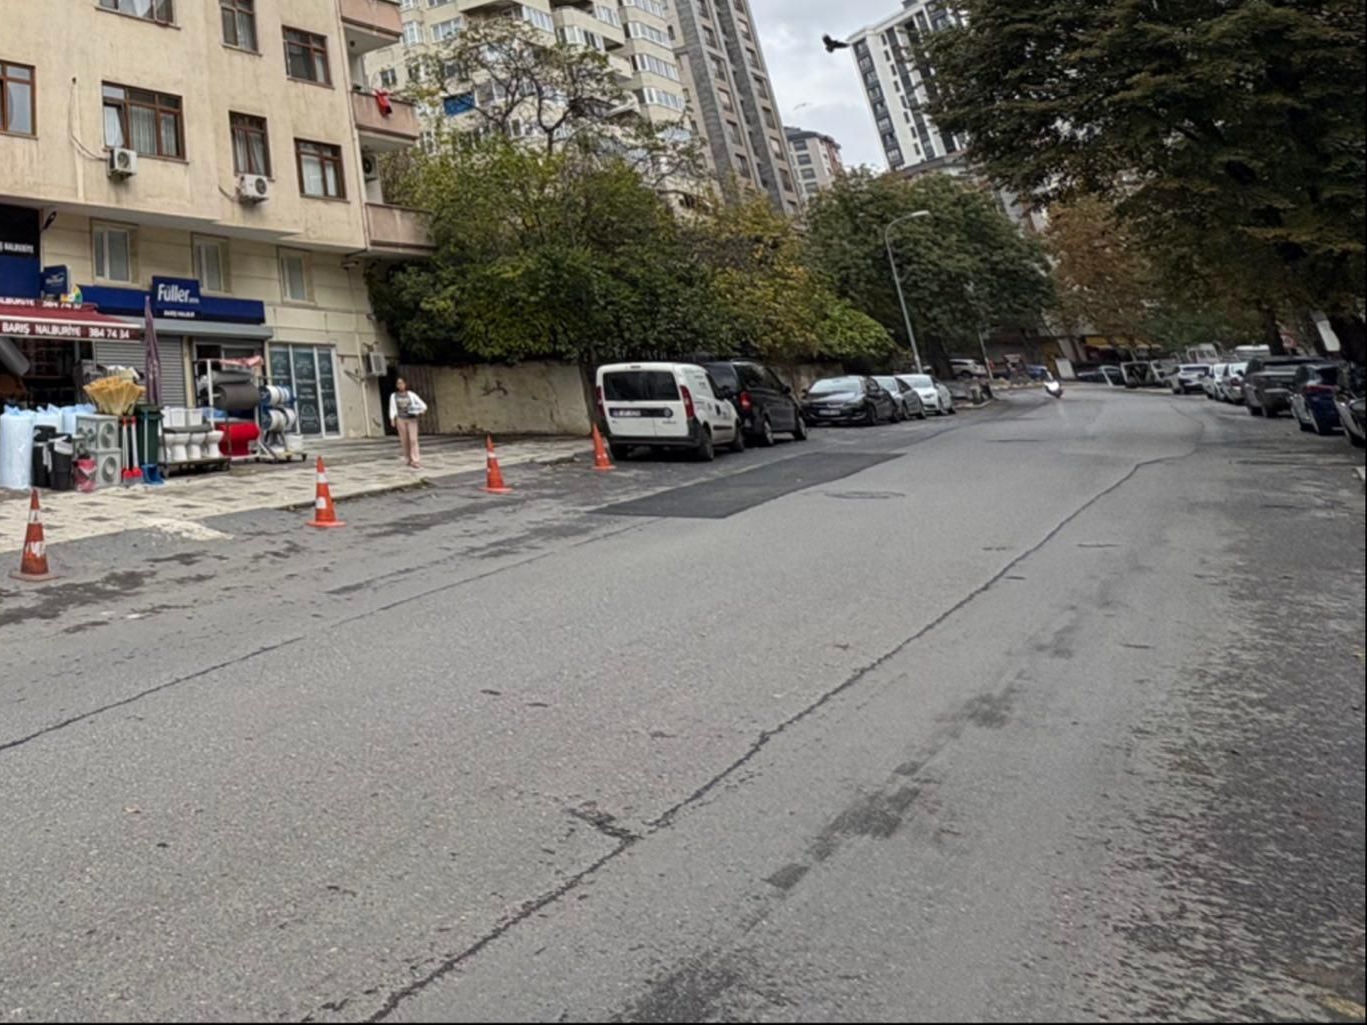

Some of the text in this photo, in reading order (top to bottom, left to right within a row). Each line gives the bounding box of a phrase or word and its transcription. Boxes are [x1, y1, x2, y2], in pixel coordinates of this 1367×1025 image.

[157, 283, 191, 303] Füller
[2, 322, 130, 339] BARIŞ NALBURİYE 384 74 34
